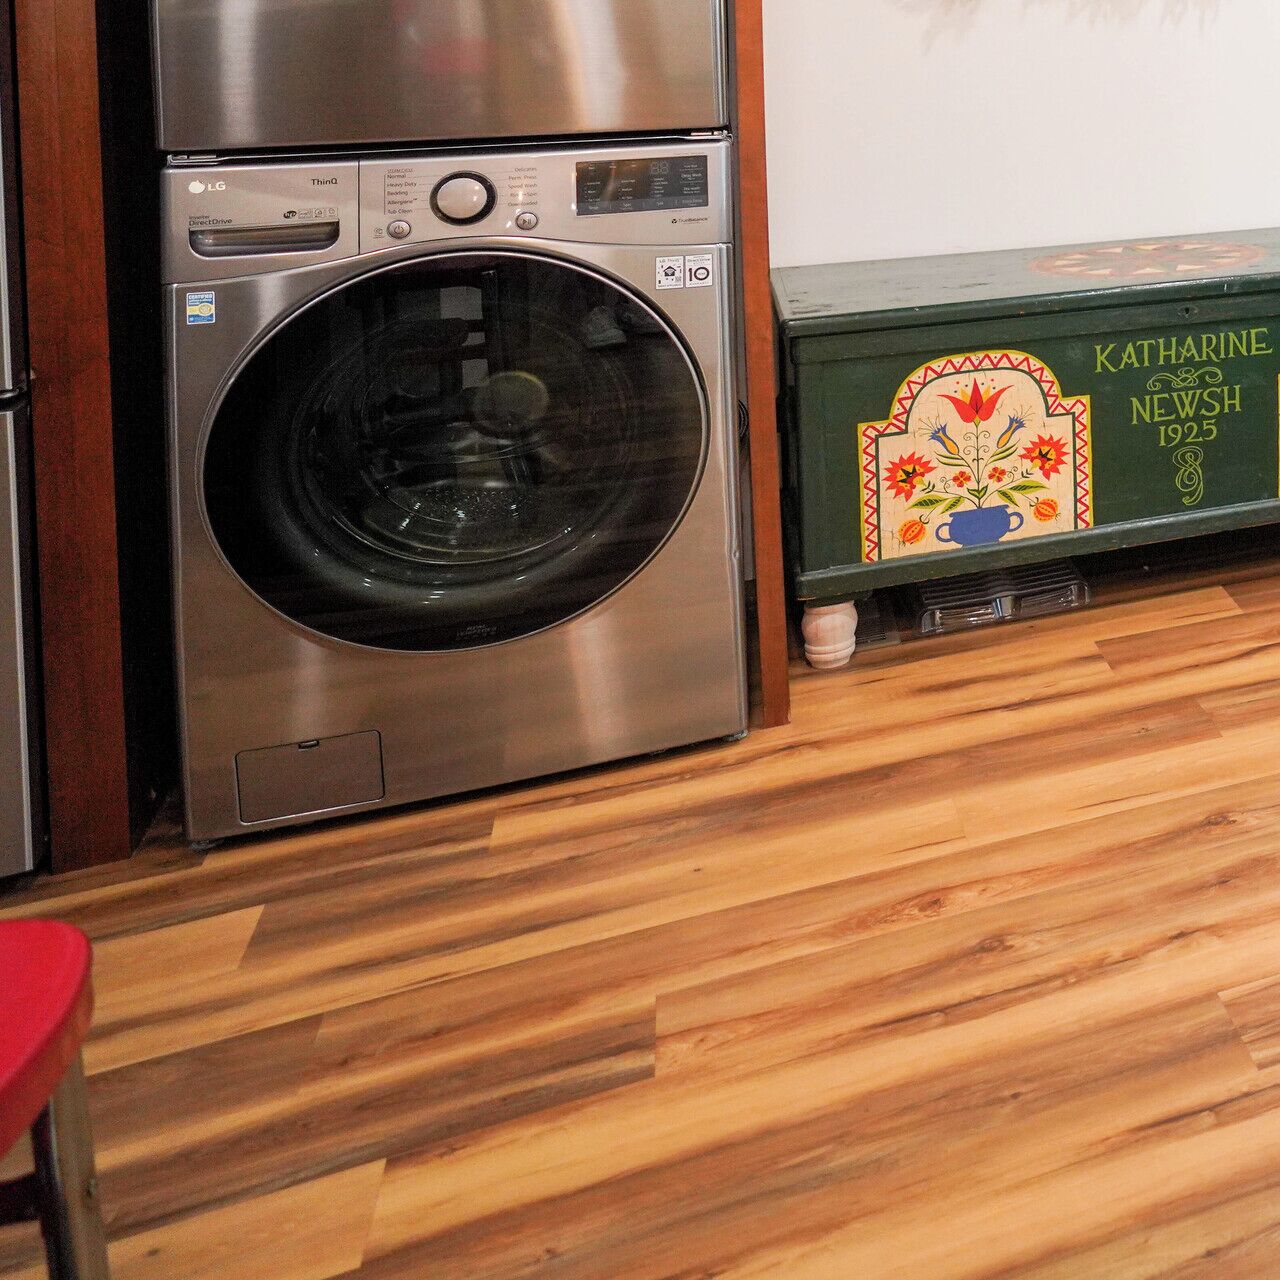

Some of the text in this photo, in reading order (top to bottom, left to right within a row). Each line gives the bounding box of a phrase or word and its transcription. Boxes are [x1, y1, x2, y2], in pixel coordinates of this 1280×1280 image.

[207, 181, 227, 191] LG
[310, 177, 338, 187] ThinQ
[1094, 328, 1273, 372] KATHARINE
[1130, 385, 1242, 425] NEWSH
[1158, 419, 1217, 447] 1925
